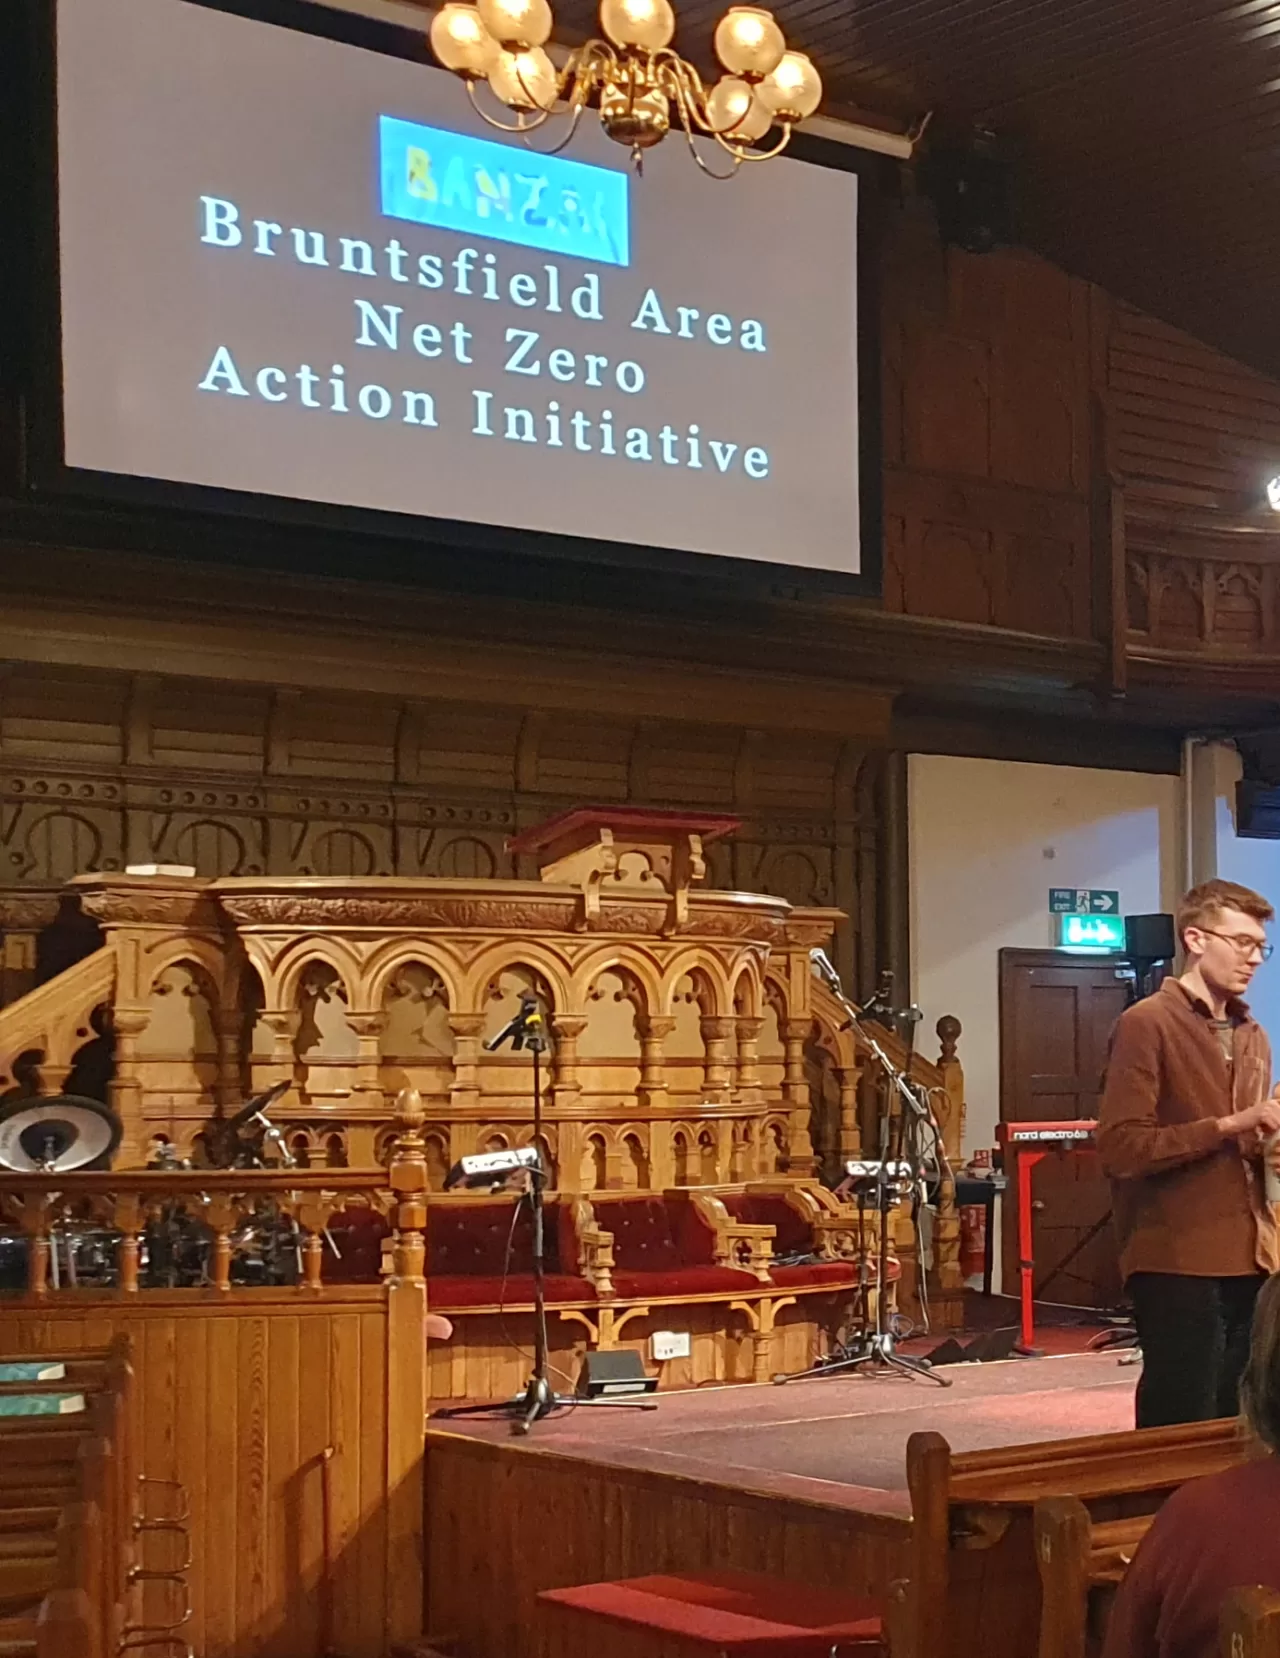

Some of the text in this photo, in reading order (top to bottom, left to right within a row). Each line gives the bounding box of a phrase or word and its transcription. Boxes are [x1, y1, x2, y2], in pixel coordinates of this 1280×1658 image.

[199, 195, 768, 353] Bruntsfield Area
[354, 299, 646, 394] Net Zero
[197, 345, 770, 479] Action Initiative
[1013, 1130, 1038, 1140] nord
